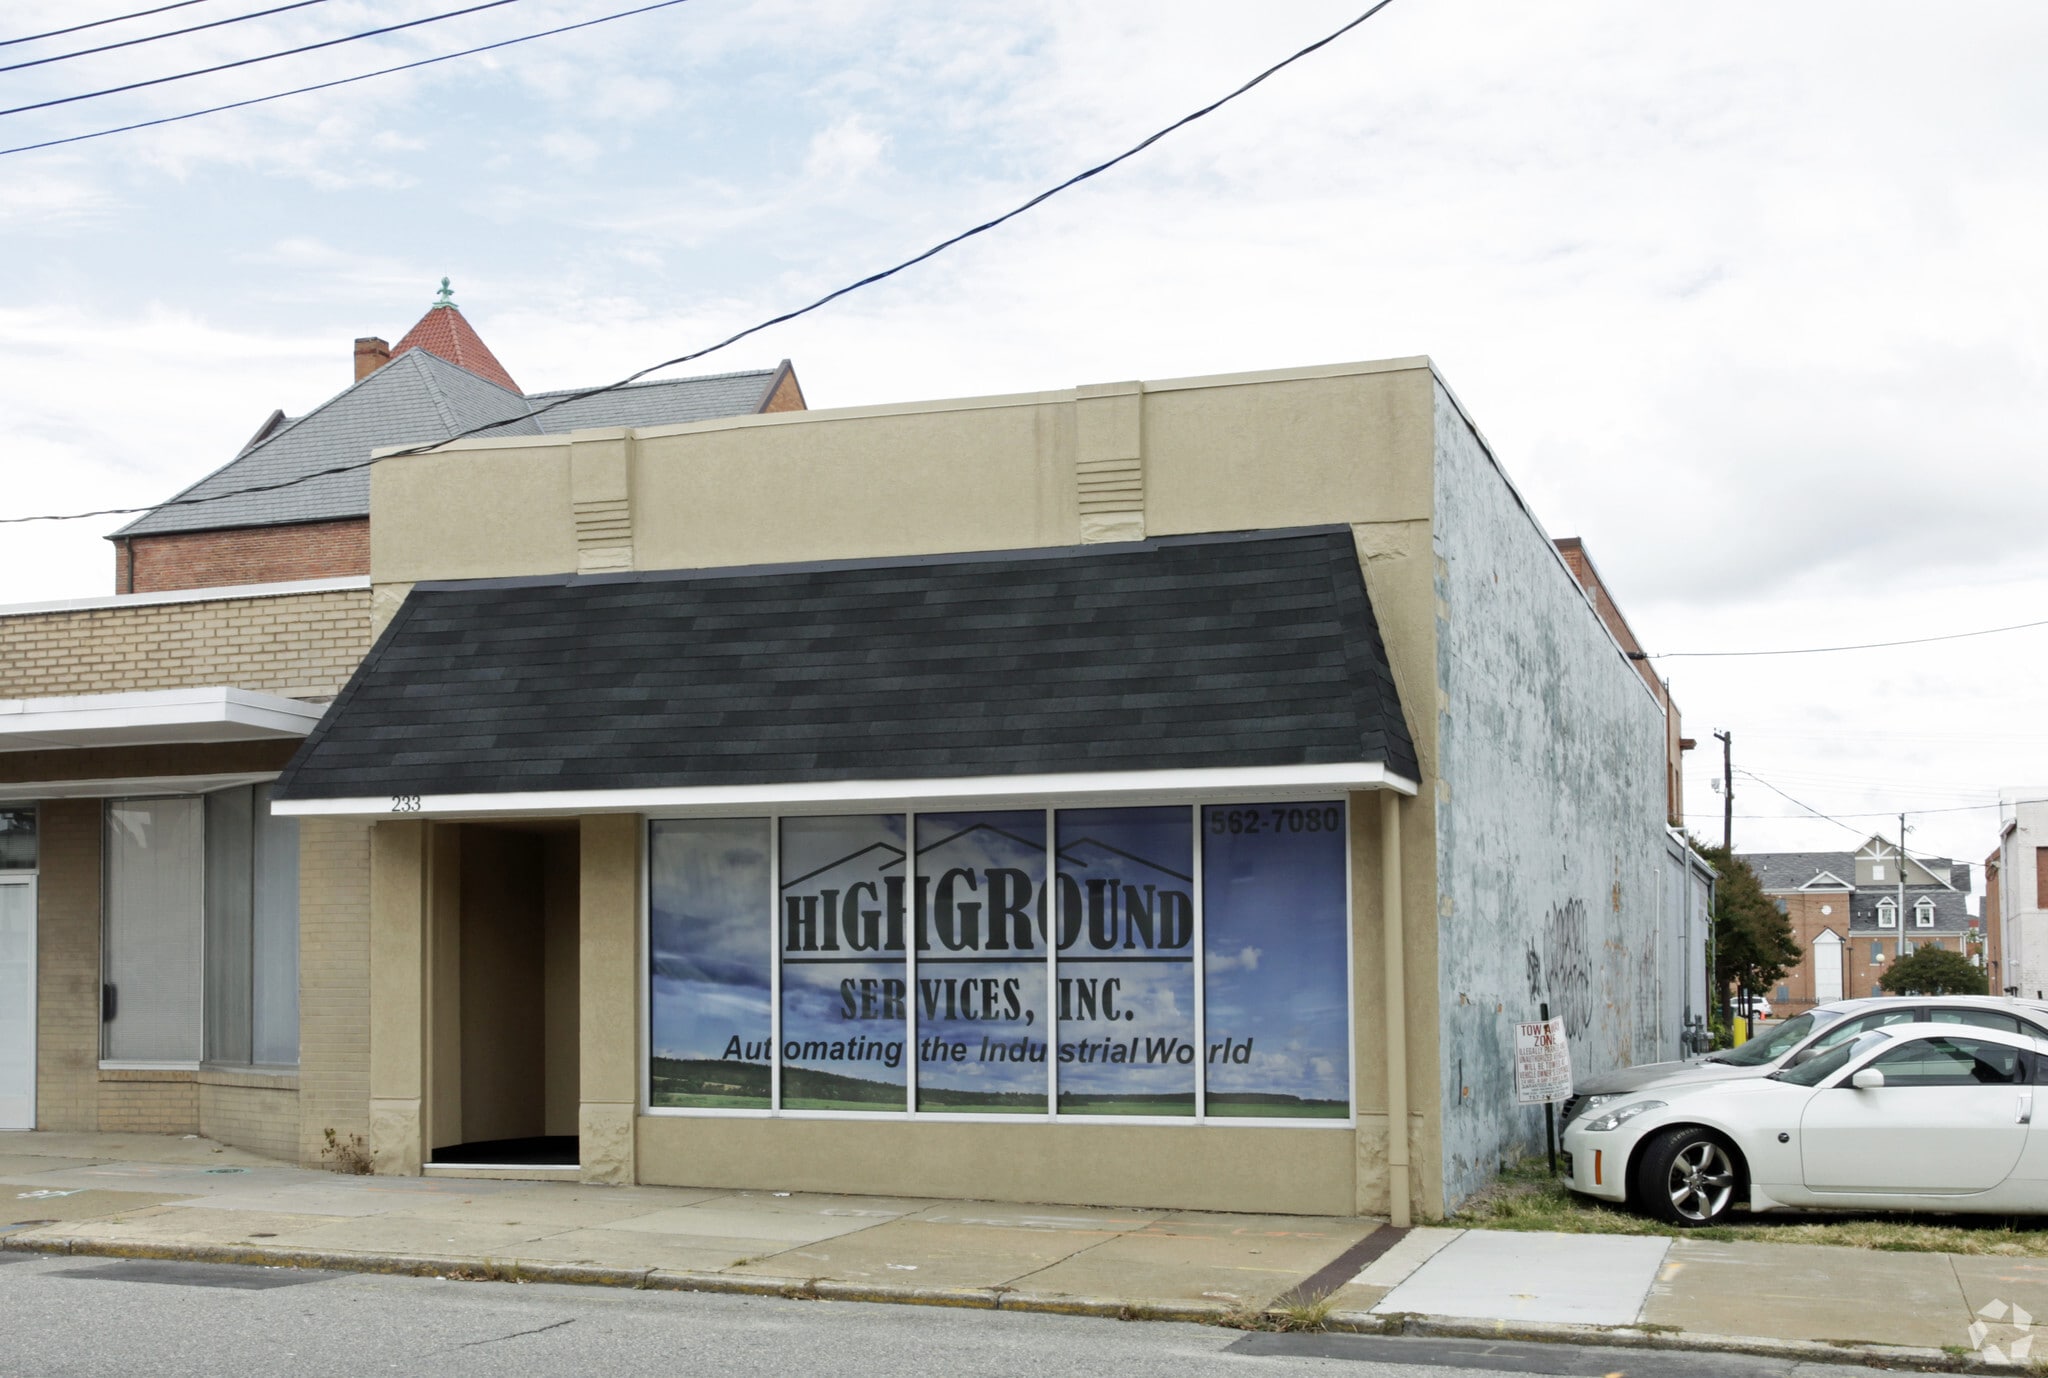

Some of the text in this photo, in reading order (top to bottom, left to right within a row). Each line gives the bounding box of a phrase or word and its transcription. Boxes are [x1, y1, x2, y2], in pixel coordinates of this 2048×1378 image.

[392, 794, 421, 812] 233
[1211, 806, 1339, 835] 562-7080
[840, 977, 1134, 1027] SERVICES, INC.
[1521, 1024, 1542, 1036] TOW
[1534, 1034, 1557, 1047] ZONE
[722, 1035, 1254, 1068] Automating the Industrial World
